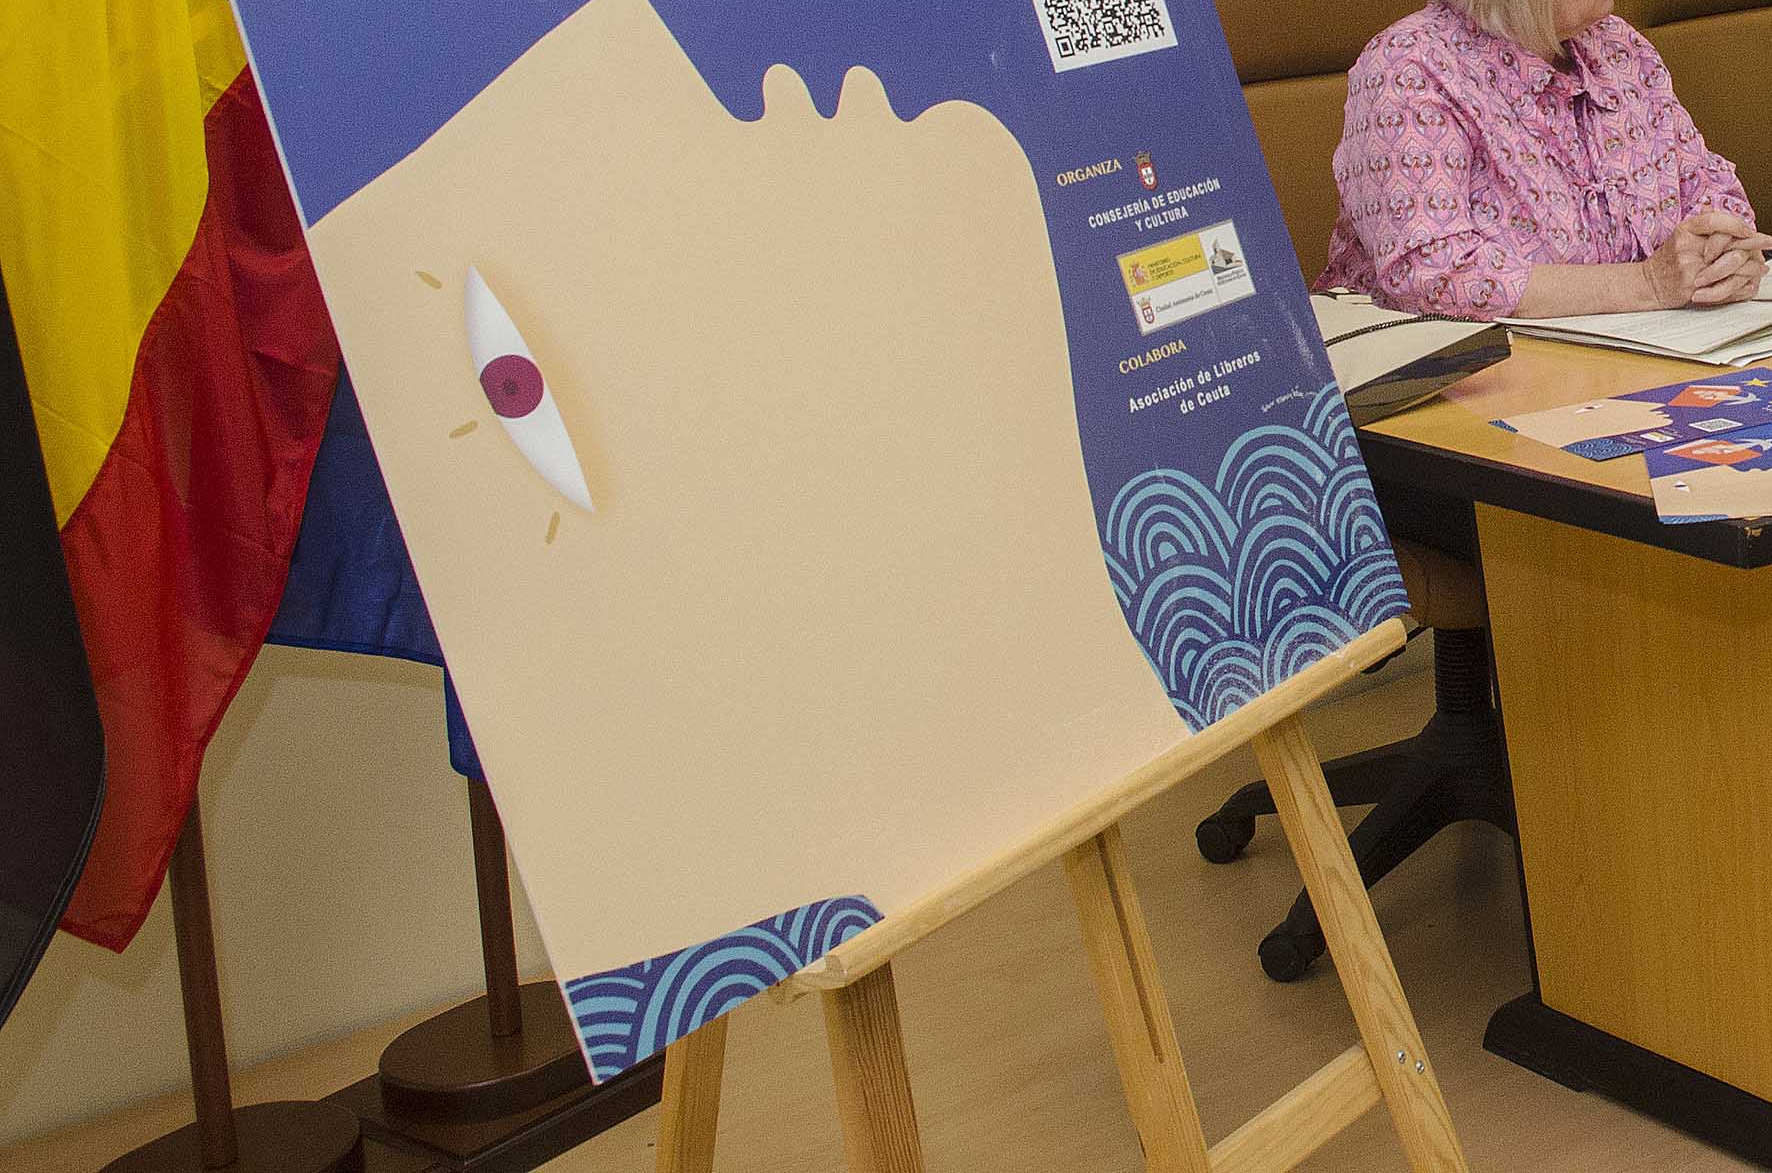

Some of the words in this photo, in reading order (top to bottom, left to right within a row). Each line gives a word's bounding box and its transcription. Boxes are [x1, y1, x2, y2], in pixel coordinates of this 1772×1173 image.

[1056, 158, 1123, 187] ORGANIZA
[1088, 198, 1151, 228] CONSEJERÍA
[1151, 194, 1167, 210] DE
[1167, 177, 1221, 204] EDUCACIÓN
[1135, 219, 1143, 232] Y
[1145, 206, 1190, 229] CULTURA
[1119, 339, 1187, 374] COLABORA
[1129, 377, 1195, 413] Asociación
[1197, 370, 1212, 385] de
[1213, 351, 1261, 378] Libreros
[1180, 399, 1195, 414] de
[1197, 385, 1231, 407] Ceuta
